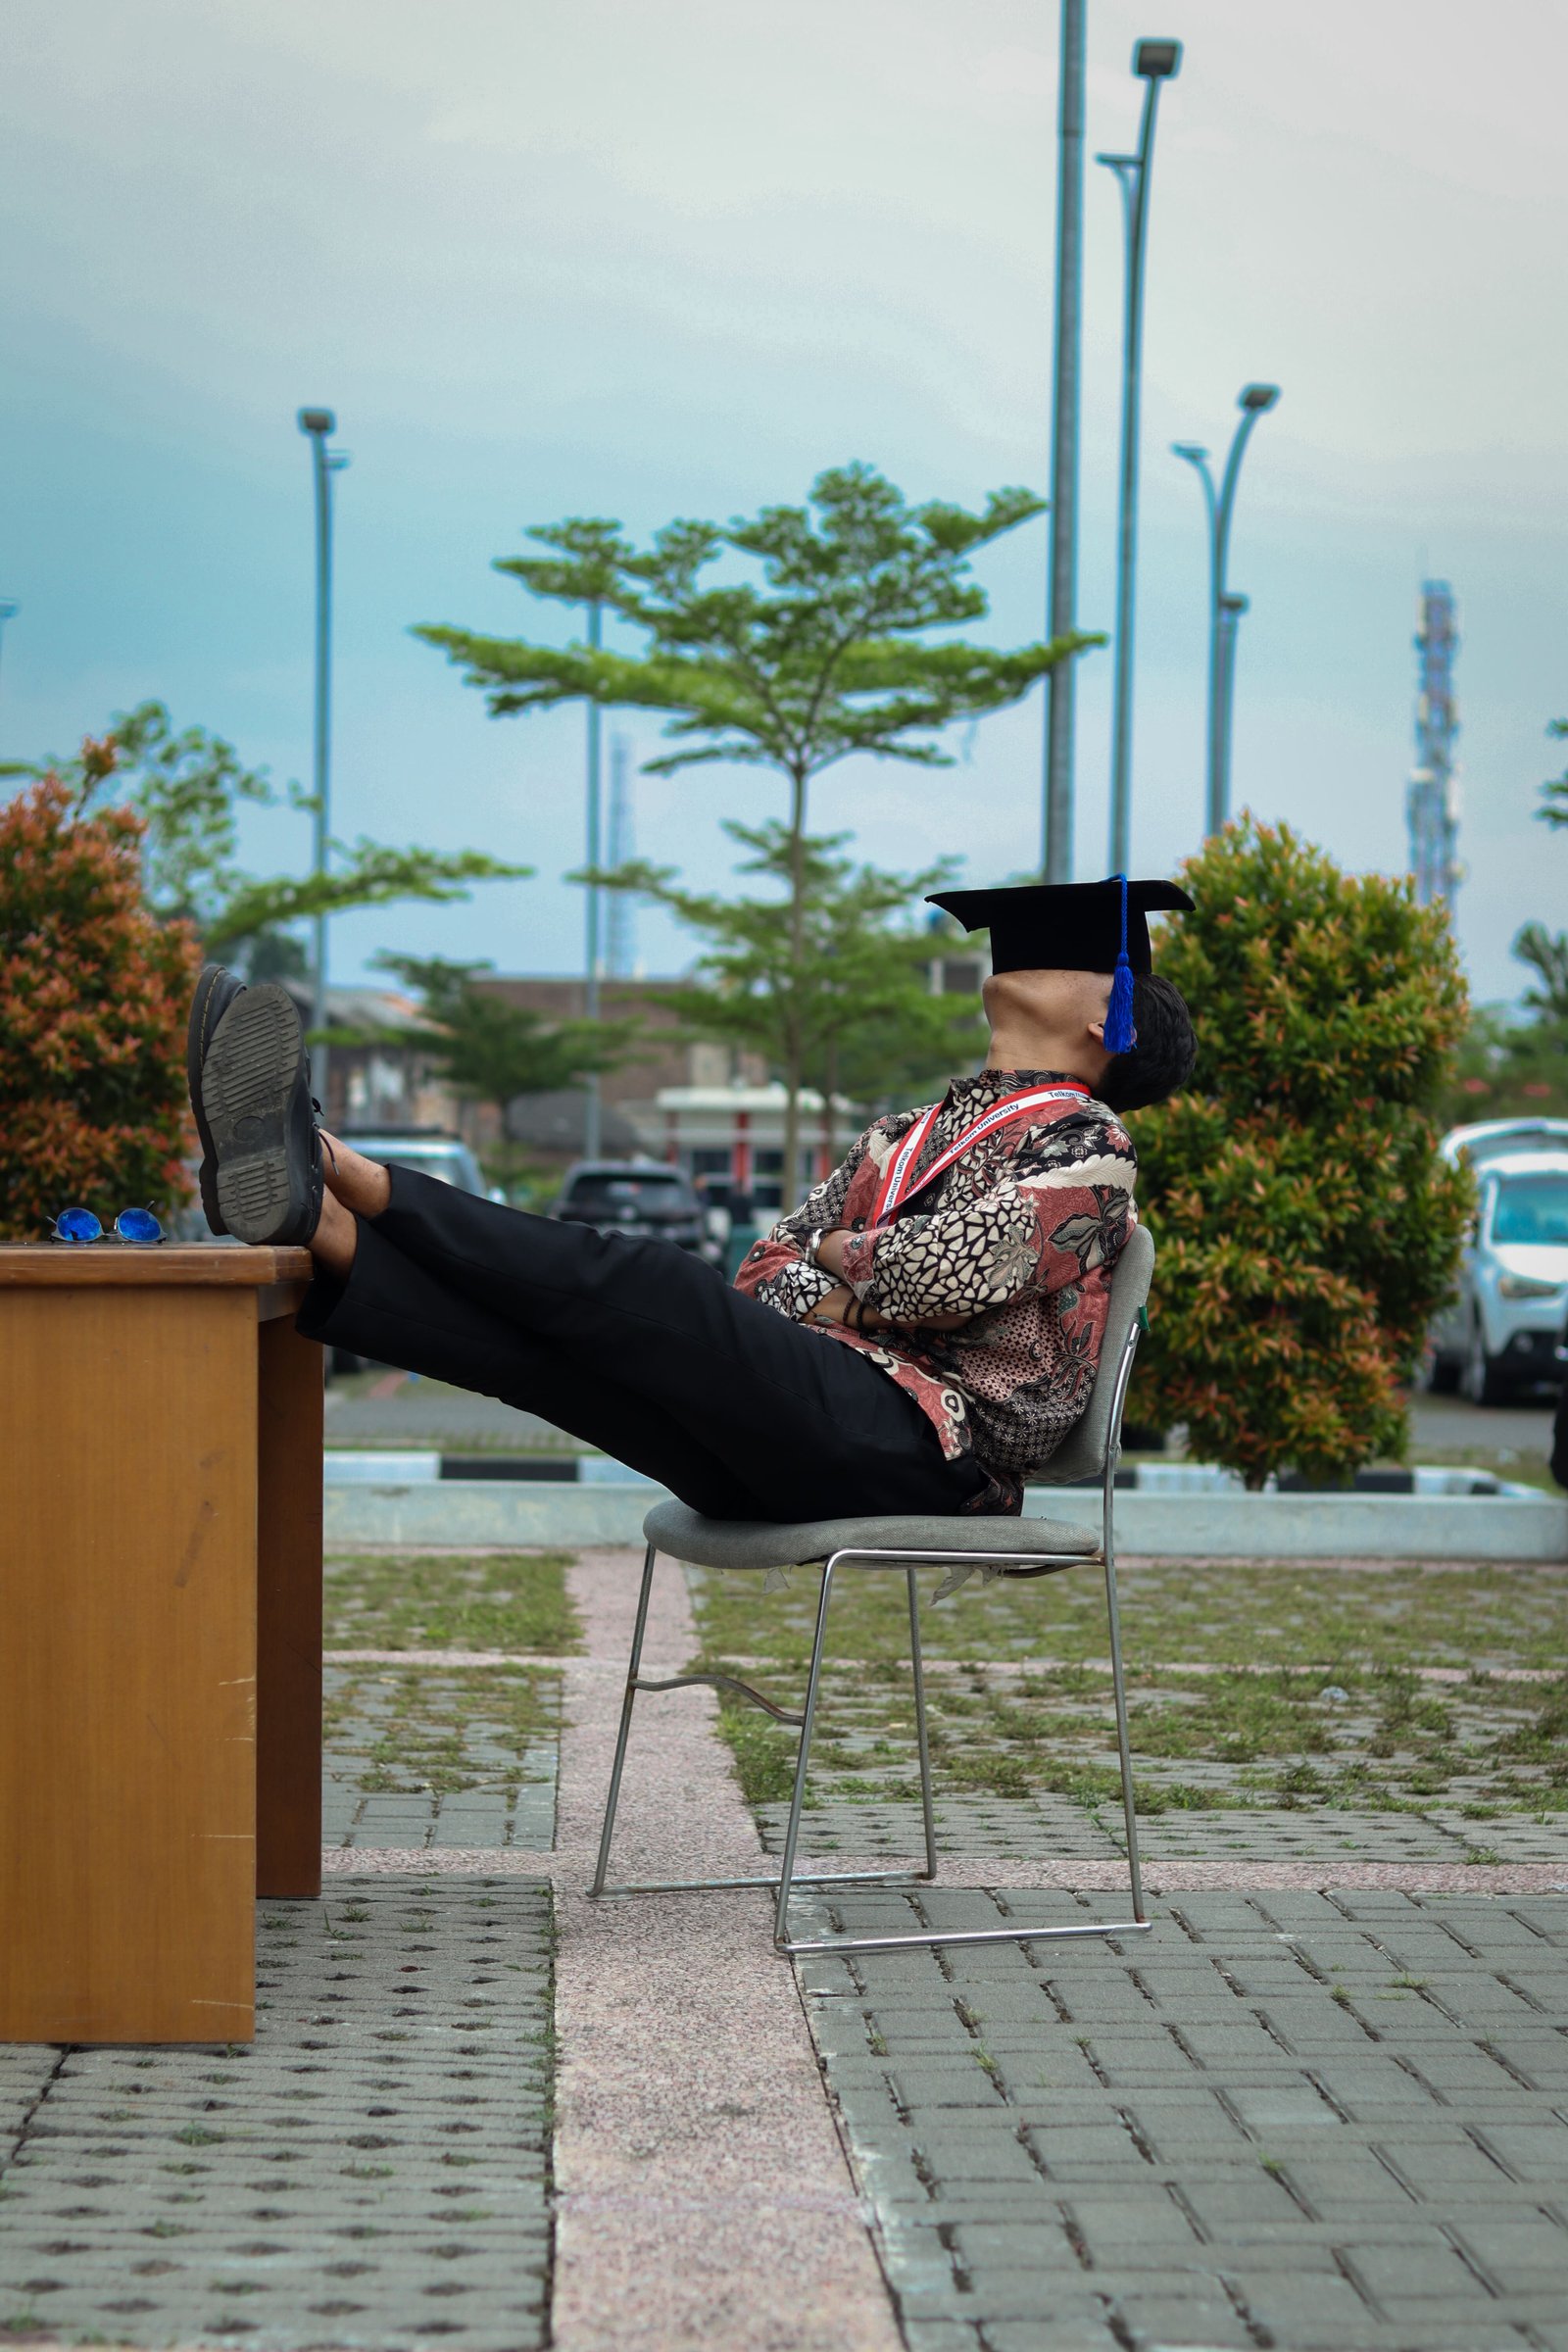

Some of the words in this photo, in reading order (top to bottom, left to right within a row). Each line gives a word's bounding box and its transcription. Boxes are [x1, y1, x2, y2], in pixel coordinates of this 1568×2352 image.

[950, 1130, 977, 1154] Telkom
[977, 1102, 1019, 1131] University
[896, 1147, 913, 1174] Telkom
